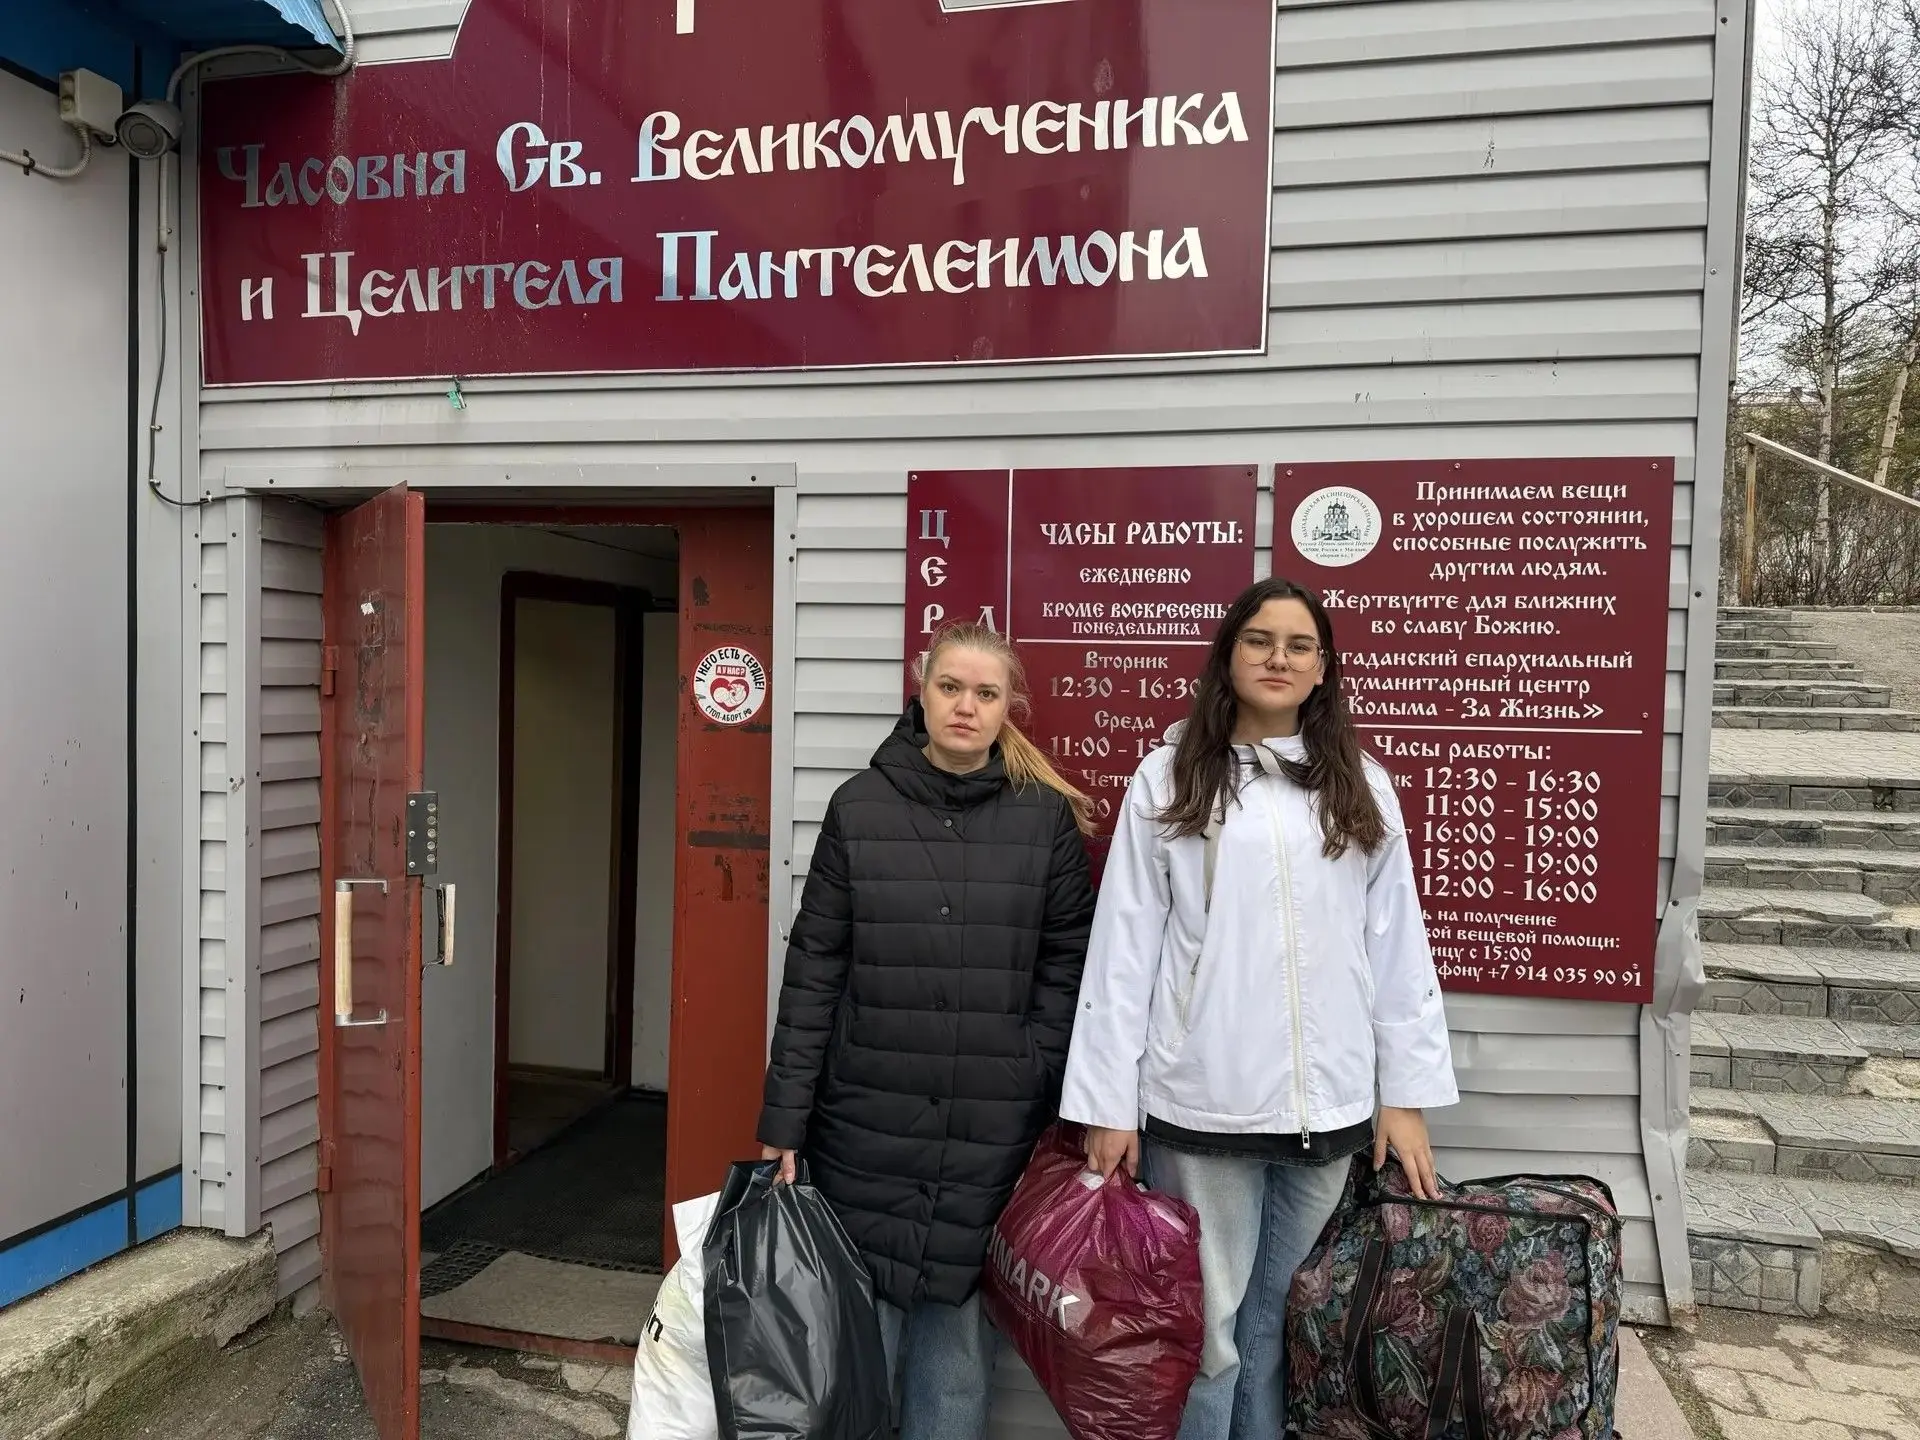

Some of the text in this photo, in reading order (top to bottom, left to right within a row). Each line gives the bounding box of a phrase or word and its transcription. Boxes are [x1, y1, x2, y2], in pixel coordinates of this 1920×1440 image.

[215, 91, 1249, 208] Часовня Св. Великомученика
[241, 227, 1208, 336] и Целителя Пантелеимона
[1417, 482, 1627, 505] Принимаем вещи
[1393, 509, 1649, 531] в хорошем состоянии,
[1040, 521, 1244, 545] ЧАСЫ РАБОТЫ:
[1393, 535, 1647, 557] способные послужить
[1430, 561, 1607, 581] другим людям.
[1042, 602, 1234, 619] КРОМЕ ВОСКРЕСЕНЬ
[1465, 595, 1506, 613] для
[1515, 595, 1616, 615] ближних
[1072, 622, 1201, 636] ПОНЕДЕЛЬНИКА
[1372, 615, 1560, 640] во славу Божию.
[698, 654, 717, 676] НЕГО
[718, 648, 740, 660] ЕСТЬ
[742, 654, 765, 690] СЕРДЦЕ!
[1085, 651, 1168, 673] Вторник
[1466, 651, 1633, 673] епархиальный
[1051, 677, 1113, 698] 12:30
[1340, 676, 1590, 699] гуманитарный центр
[1461, 698, 1491, 719] За
[1499, 698, 1604, 720] Жизнь»
[1095, 711, 1155, 733] Среда
[1050, 736, 1109, 758] 11:00
[1373, 735, 1551, 764] Часы работы:
[1425, 766, 1497, 790] 12:30
[1527, 769, 1600, 793] 16:30
[1426, 794, 1495, 817] 11:00
[1524, 797, 1598, 820] 15:00
[1423, 820, 1495, 845] 16:00
[1525, 824, 1598, 848] 19:00
[1423, 848, 1495, 872] 15:00
[1524, 852, 1598, 876] 19:00
[1422, 874, 1494, 899] 12:00
[1524, 879, 1597, 904] 16:00
[1438, 910, 1458, 922] на
[1464, 911, 1557, 928] получение
[1457, 929, 1536, 945] вещевой
[1542, 934, 1620, 950] помощи:
[1469, 948, 1477, 959] с
[1484, 945, 1532, 962] 15:00
[1488, 964, 1510, 980] +7
[1515, 965, 1548, 982] 914
[1553, 967, 1586, 984] 035
[1594, 969, 1616, 985] 90
[1622, 971, 1642, 987] 91
